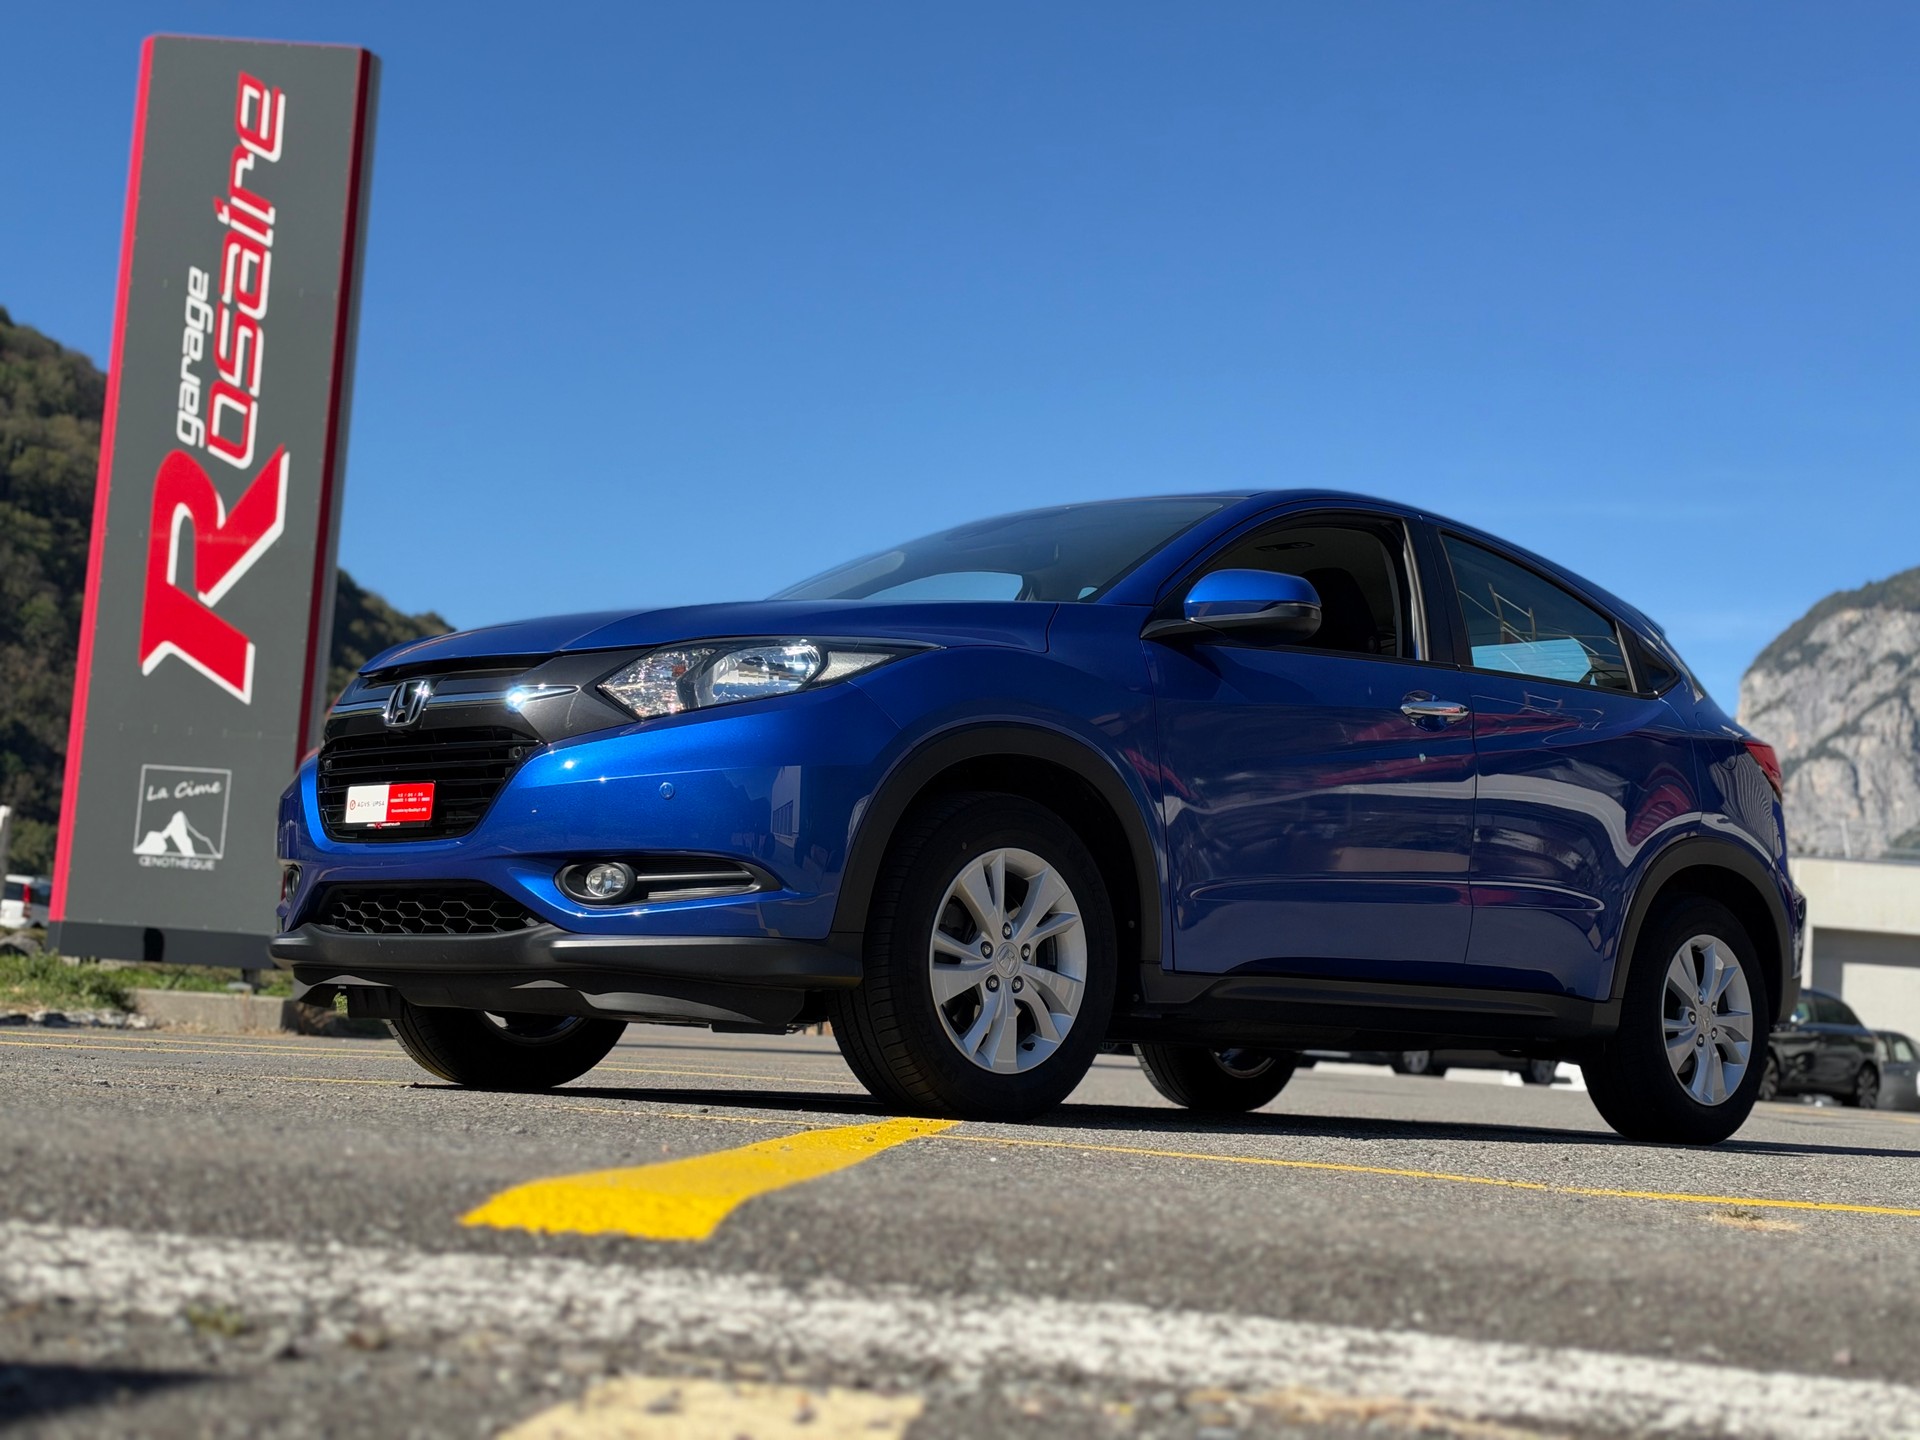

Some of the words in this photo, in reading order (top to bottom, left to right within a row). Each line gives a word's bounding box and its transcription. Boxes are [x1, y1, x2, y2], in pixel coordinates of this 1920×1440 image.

[176, 265, 214, 449] garage
[146, 785, 169, 801] La
[174, 780, 222, 799] Cime
